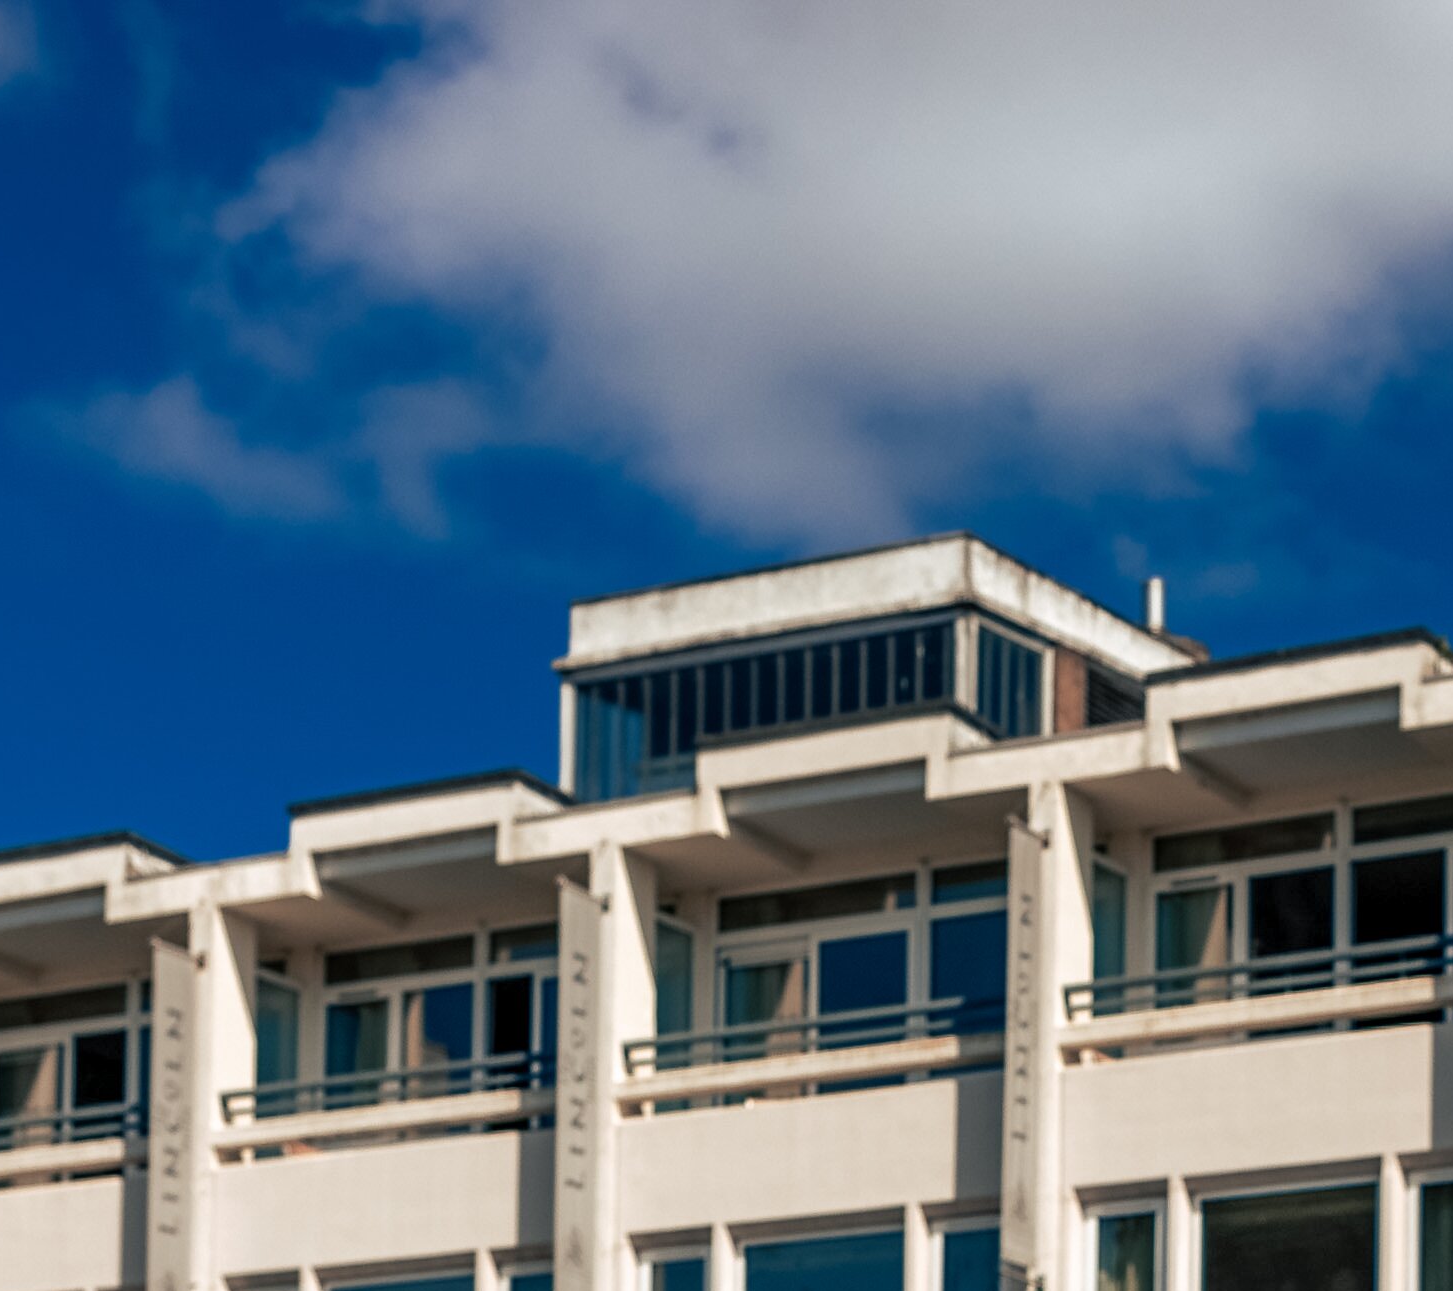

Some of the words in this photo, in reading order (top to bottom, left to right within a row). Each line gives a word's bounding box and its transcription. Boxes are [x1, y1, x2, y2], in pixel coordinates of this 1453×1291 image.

[156, 1005, 184, 1238] LINCOLN
[562, 949, 590, 1192] LINCOLN
[1009, 891, 1034, 1143] LINCOLN
